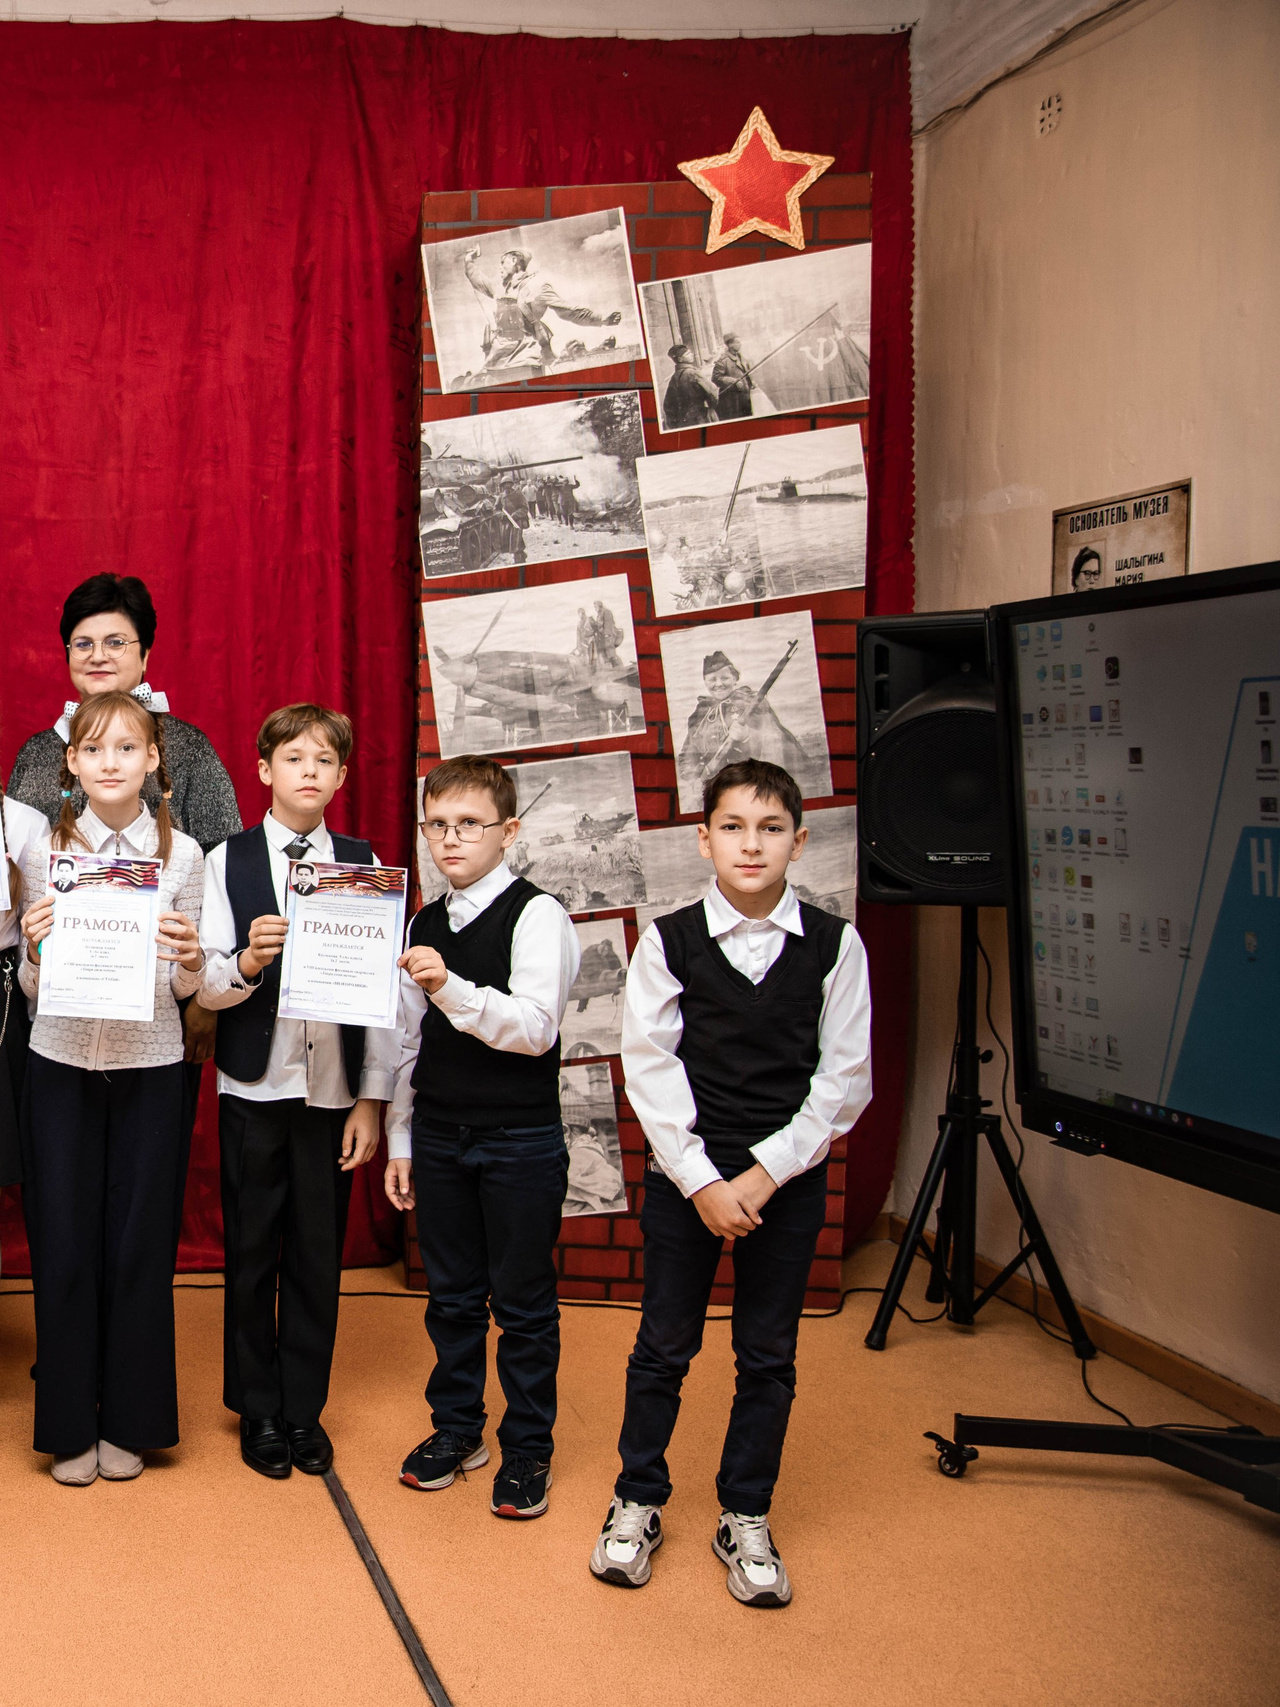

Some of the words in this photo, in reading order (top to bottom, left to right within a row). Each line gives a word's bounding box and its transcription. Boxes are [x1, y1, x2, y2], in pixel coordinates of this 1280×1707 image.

[1069, 505, 1128, 534] ОСНОВАТЕЛЬ
[1133, 495, 1169, 520] МУЗЕЯ
[1115, 552, 1164, 571] ШАЛЫГИНА
[1115, 572, 1144, 586] МАРИЯ
[63, 916, 141, 933] ГРАМОТА
[303, 920, 386, 939] ГРАМОТА
